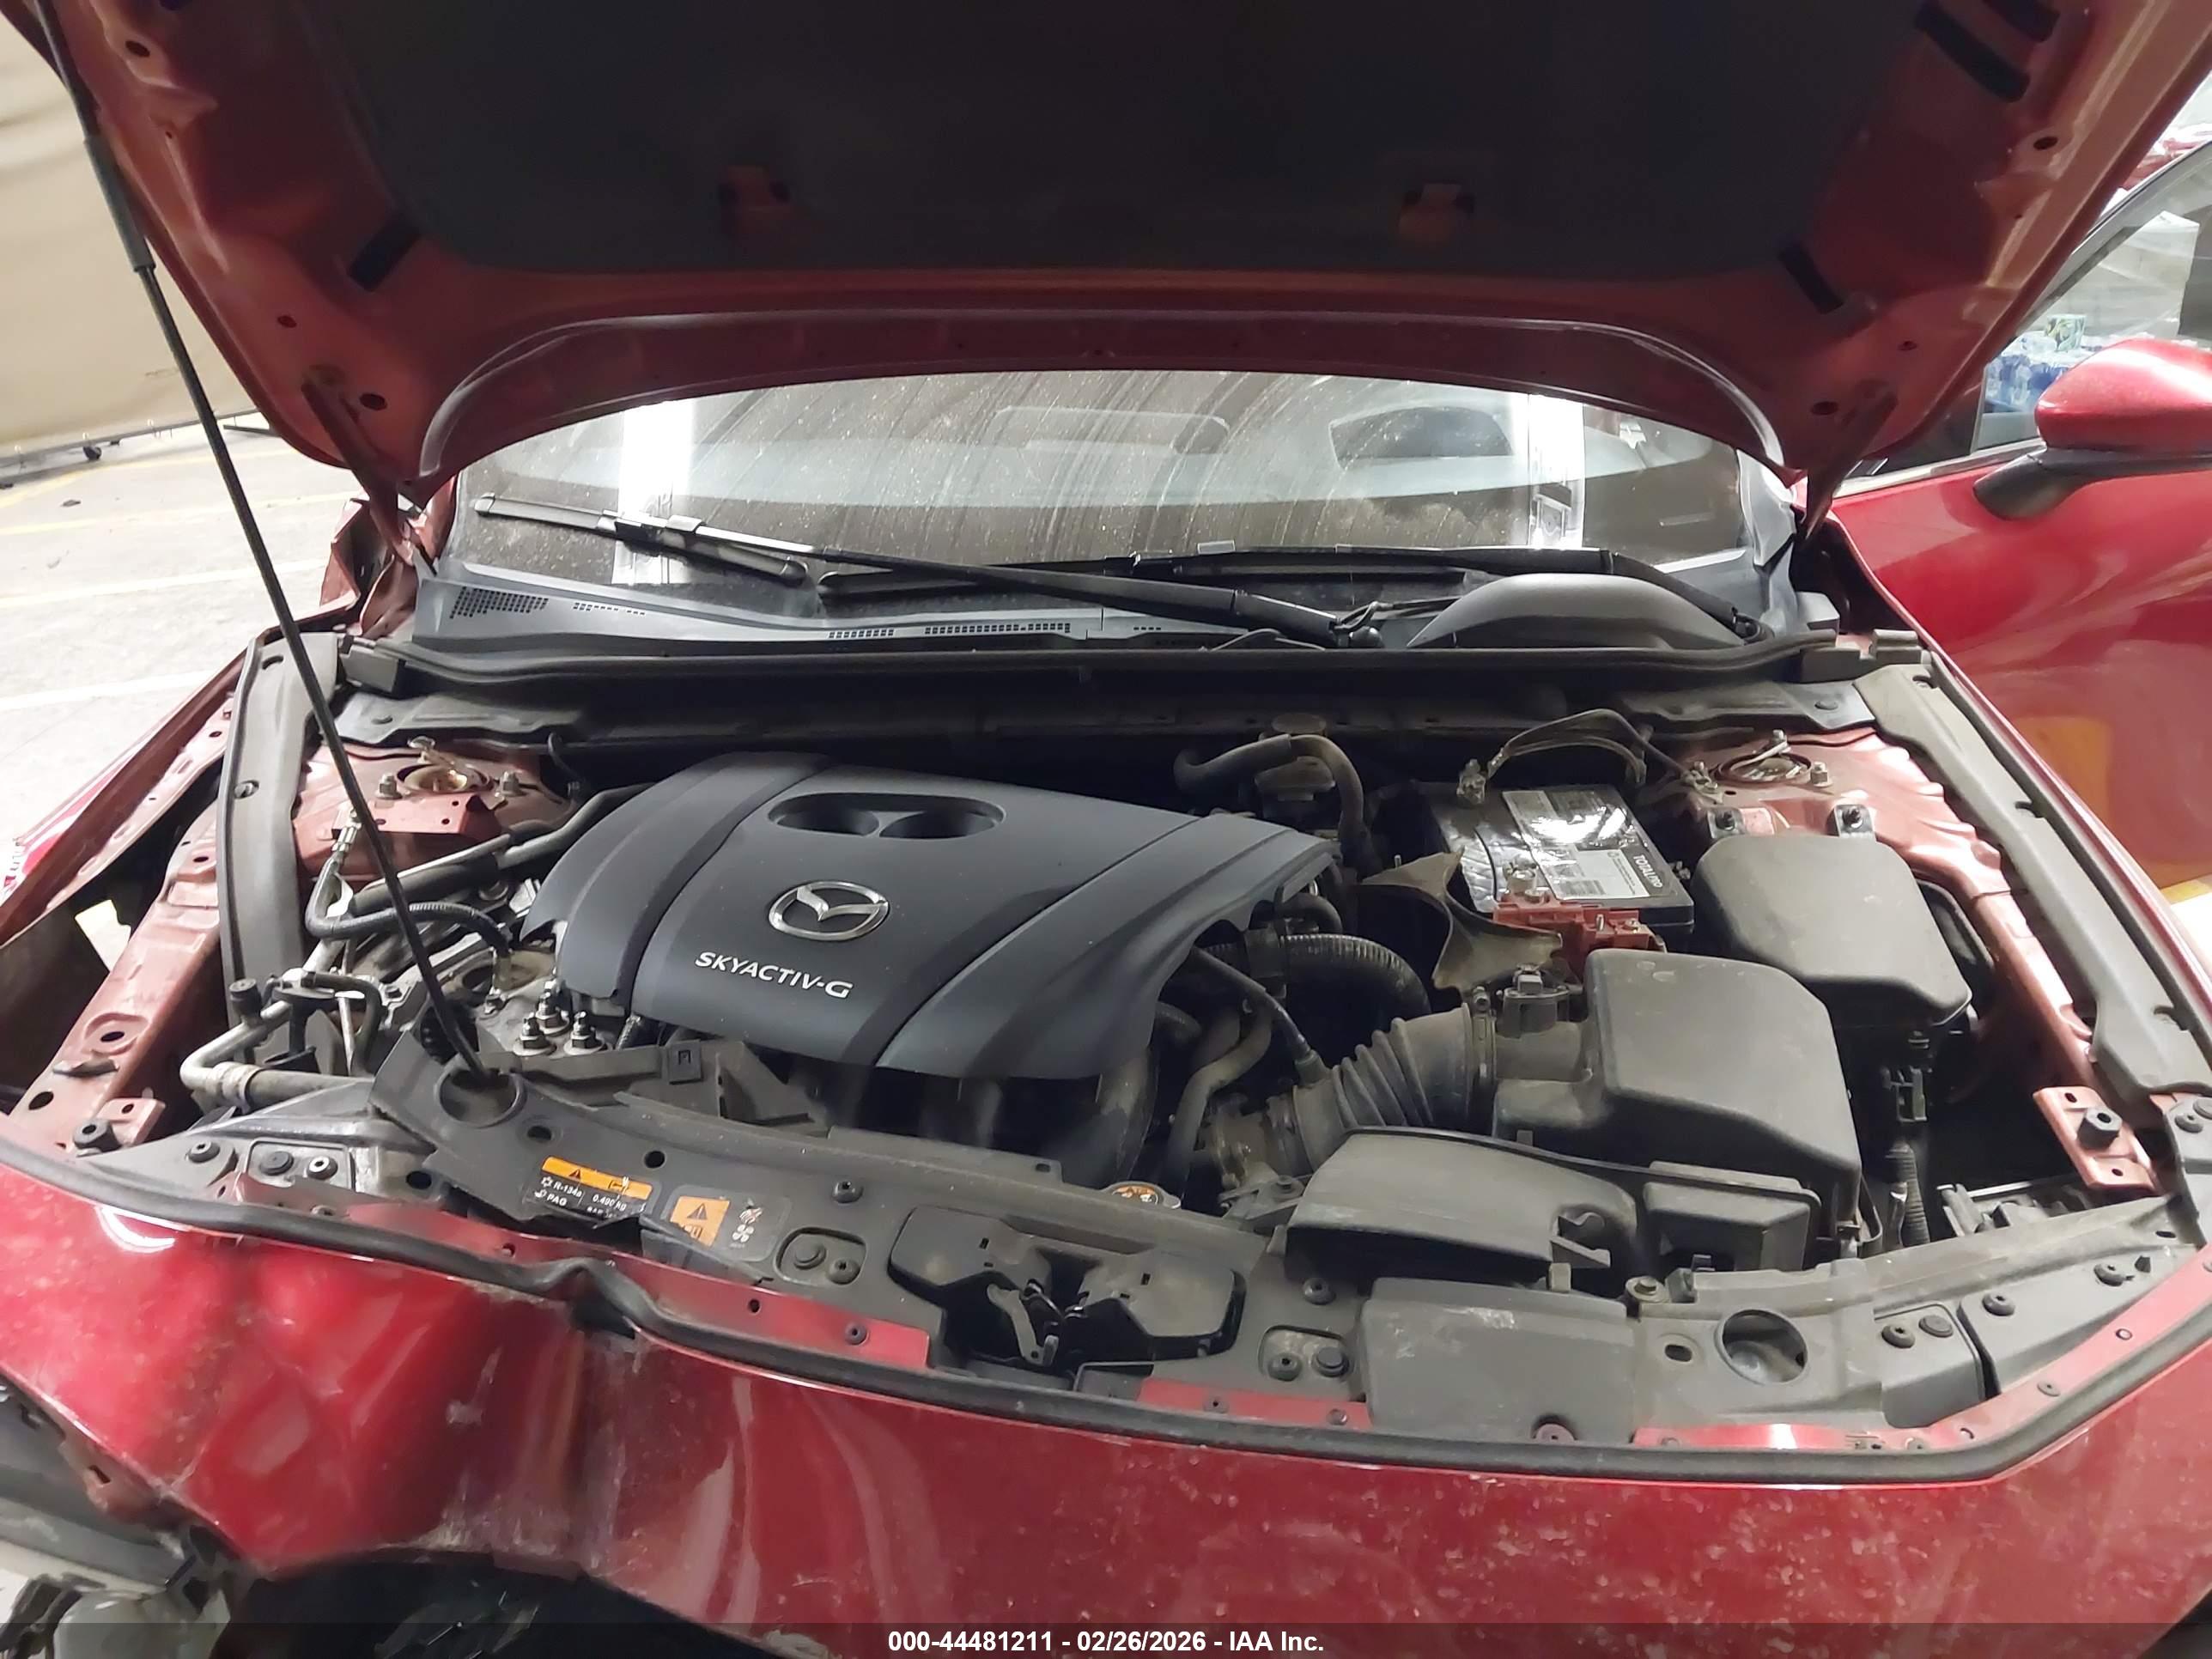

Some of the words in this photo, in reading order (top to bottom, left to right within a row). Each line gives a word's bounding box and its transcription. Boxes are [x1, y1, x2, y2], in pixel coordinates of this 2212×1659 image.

[695, 951, 854, 999] SKYACTIV-G
[553, 1181, 582, 1198] R-134a
[547, 1193, 568, 1206] PAG
